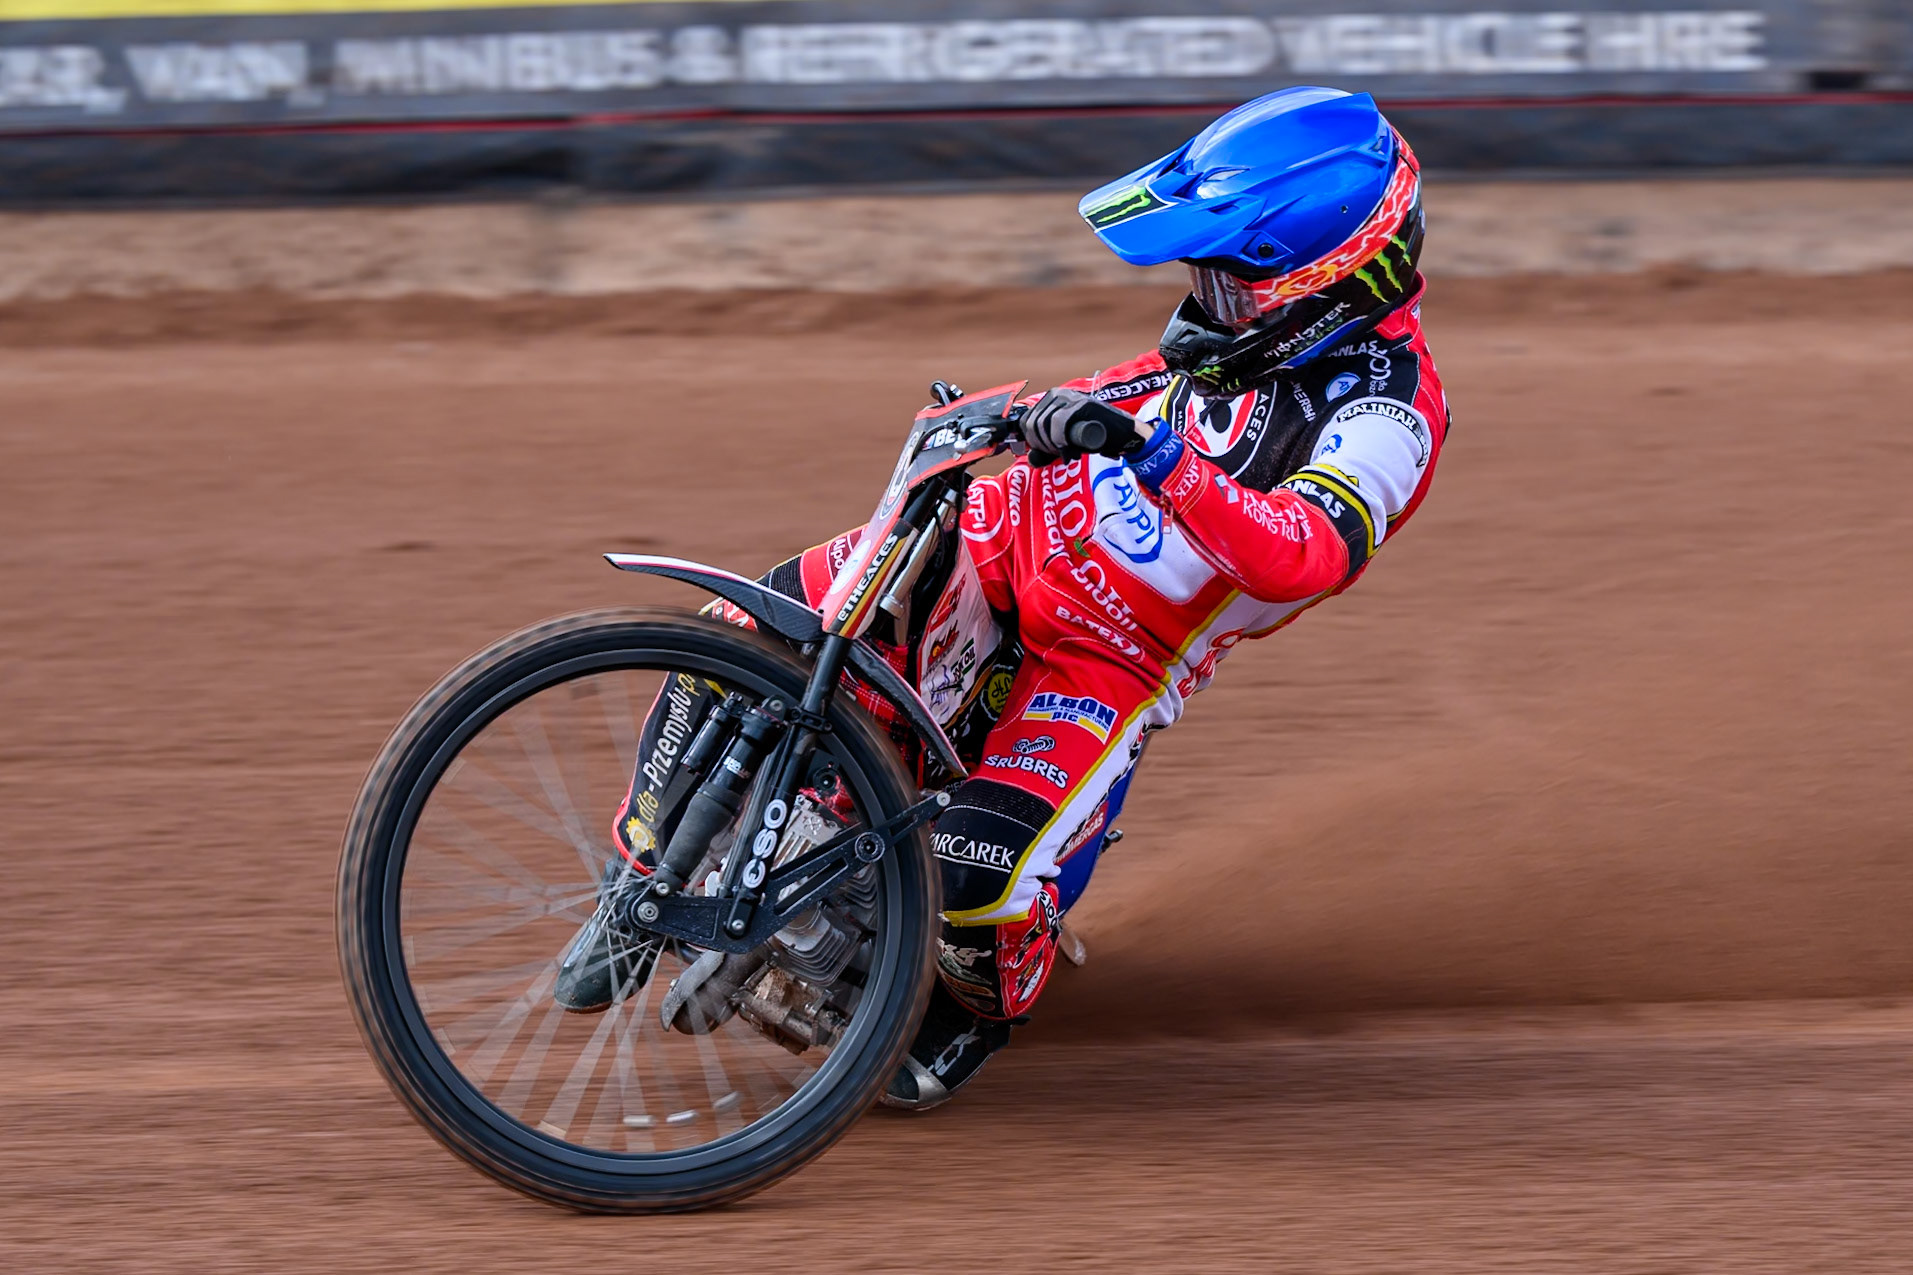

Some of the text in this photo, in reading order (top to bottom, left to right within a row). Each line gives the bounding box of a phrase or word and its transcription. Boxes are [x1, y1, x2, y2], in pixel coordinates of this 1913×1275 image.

[1246, 395, 1269, 443] ACES
[1009, 472, 1023, 527] WIKO
[830, 538, 848, 572] Alpo
[1056, 606, 1126, 648] BATEX
[1030, 694, 1116, 727] ALBON
[929, 832, 1014, 869] ARCAREK
